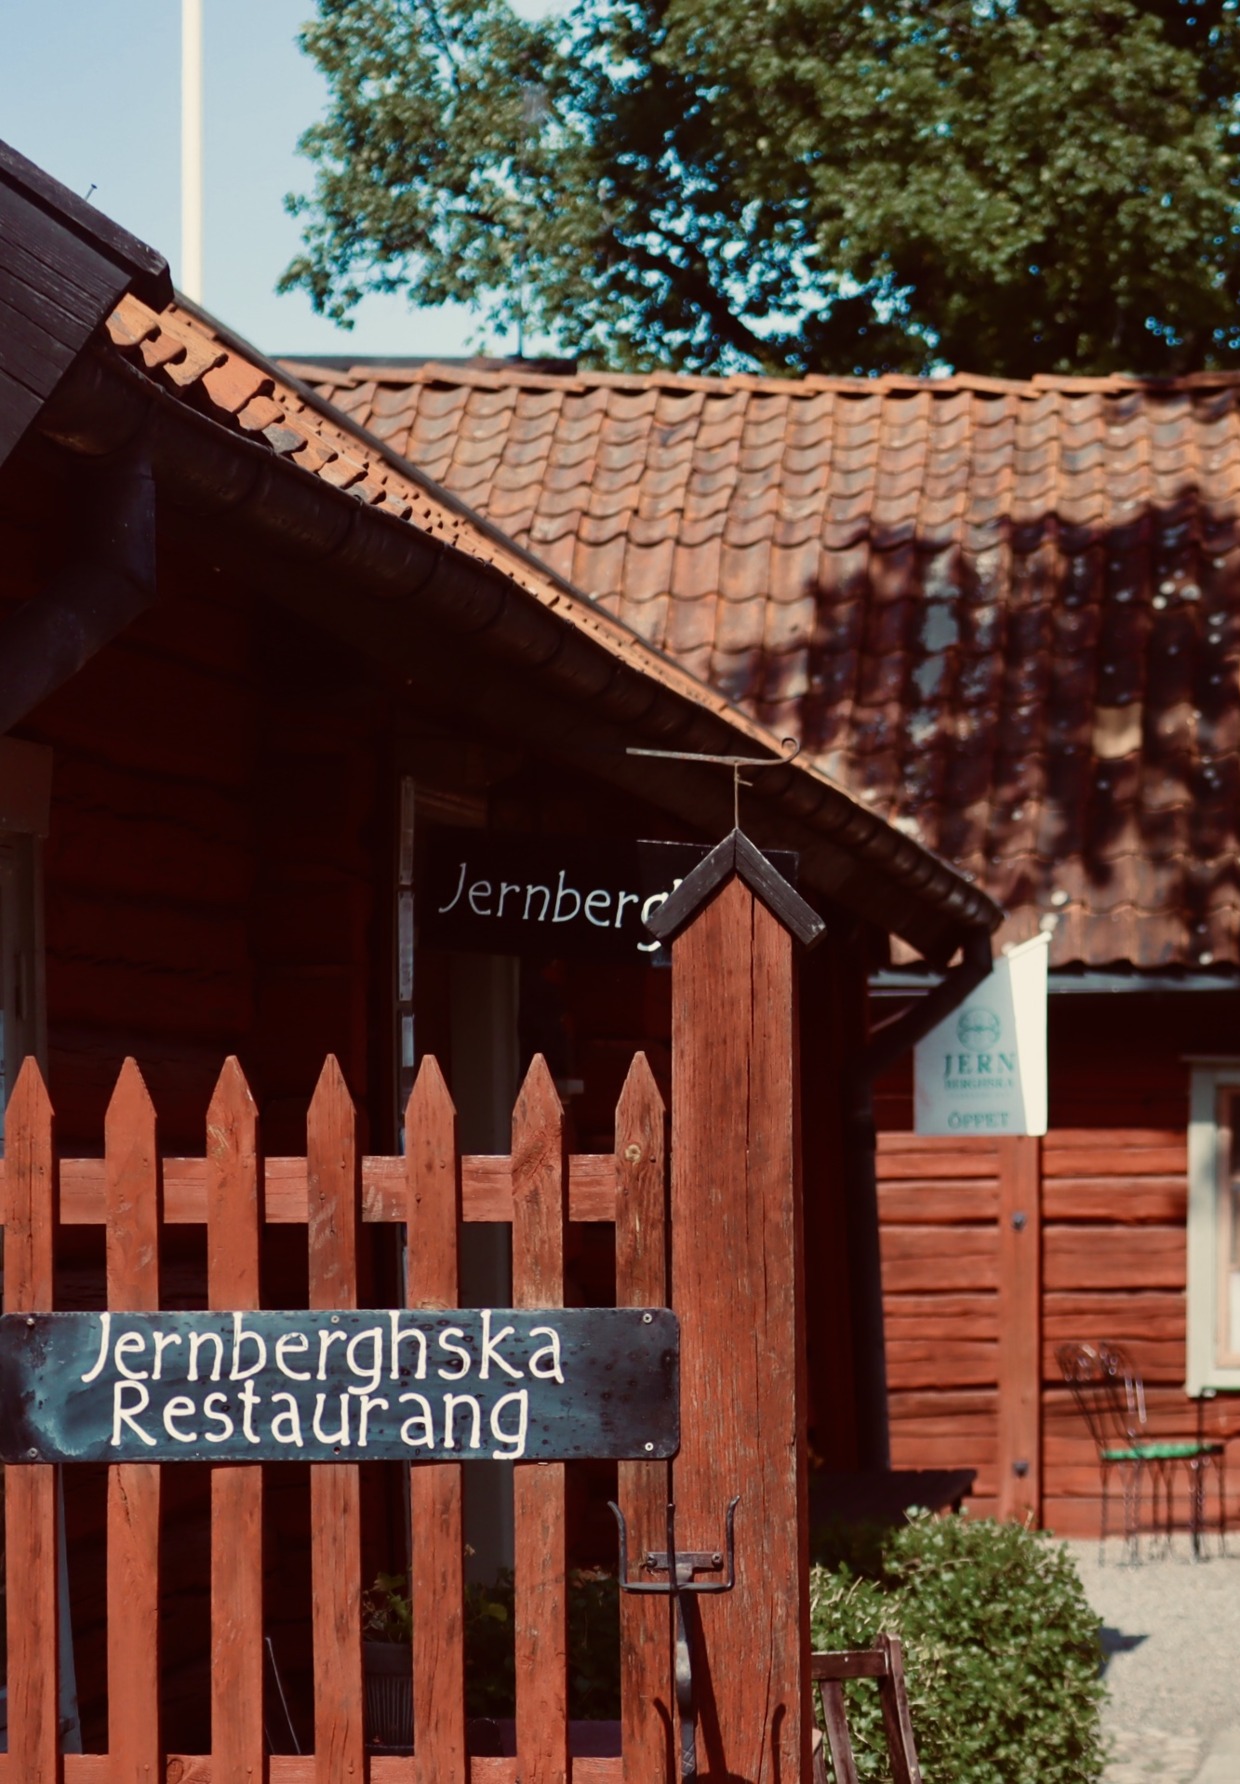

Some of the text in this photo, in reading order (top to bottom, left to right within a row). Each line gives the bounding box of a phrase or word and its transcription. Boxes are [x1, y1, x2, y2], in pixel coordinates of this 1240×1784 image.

[438, 861, 683, 951] Jernberg
[944, 1053, 1016, 1078] JERN
[947, 1110, 1009, 1129] ÖPPET
[82, 1311, 564, 1396] Jernberghska
[110, 1379, 529, 1461] Restaurang
